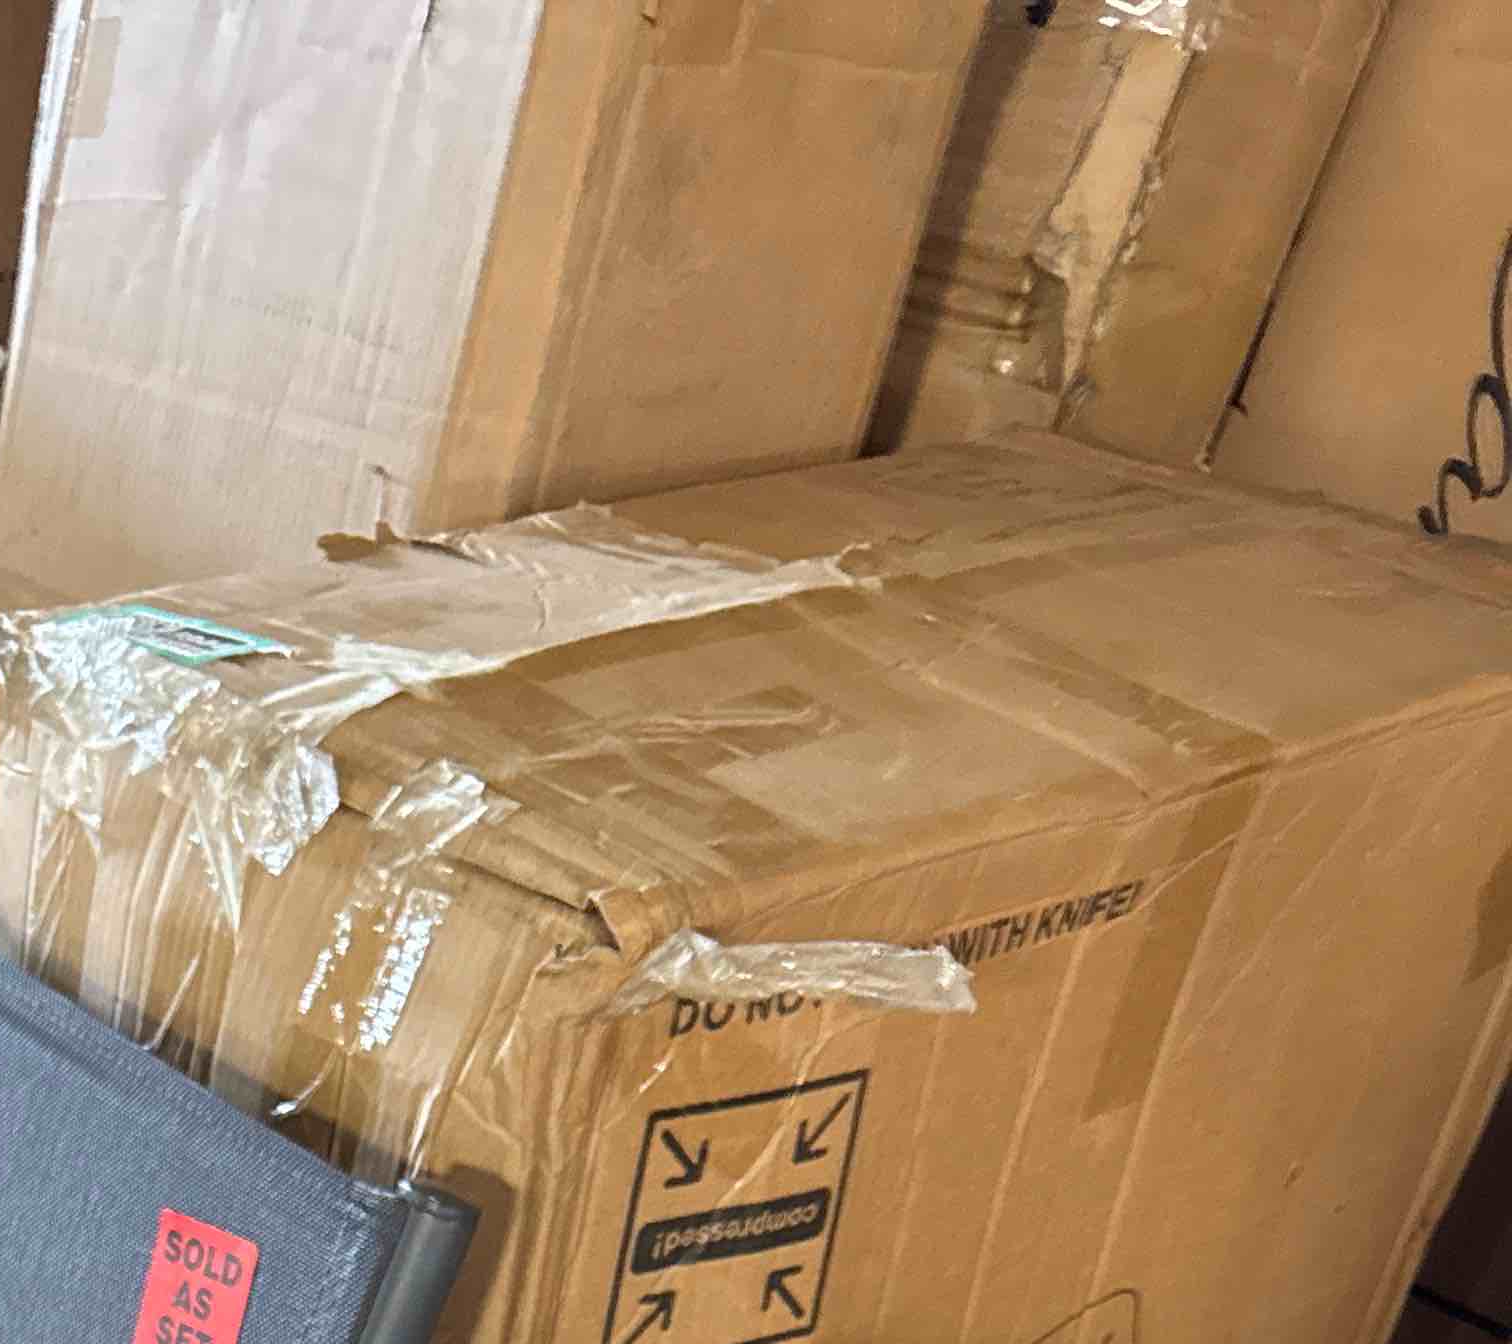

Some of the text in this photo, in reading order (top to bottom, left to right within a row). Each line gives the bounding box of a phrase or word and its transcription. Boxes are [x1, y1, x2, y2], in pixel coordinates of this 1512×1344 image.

[745, 990, 822, 1025] NO
[948, 913, 1033, 967] WITH
[163, 1229, 243, 1287] SOLD
[172, 1280, 214, 1321] AS
